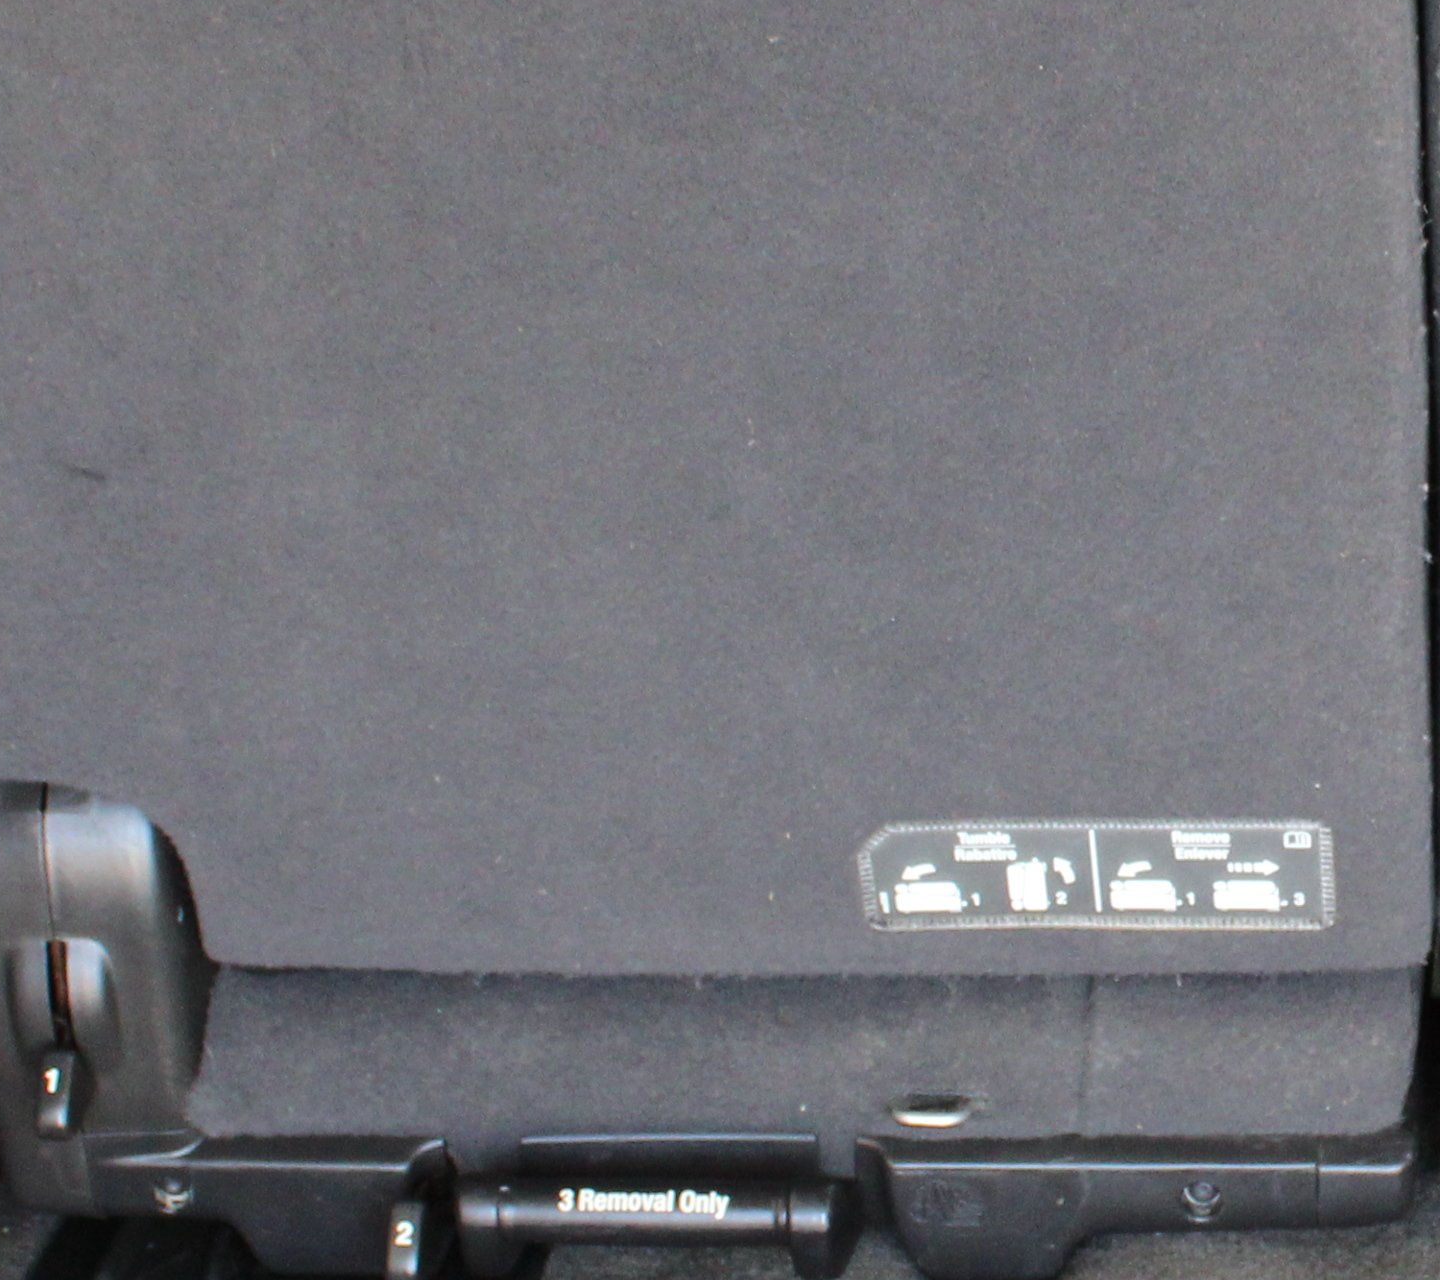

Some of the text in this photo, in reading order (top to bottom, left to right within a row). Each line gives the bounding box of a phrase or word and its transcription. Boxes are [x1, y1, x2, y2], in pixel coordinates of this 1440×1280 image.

[957, 831, 1011, 845] Tumble
[1171, 830, 1231, 844] Remove
[970, 892, 981, 906] 1
[1055, 891, 1068, 905] 2
[1186, 892, 1196, 906] 1
[1293, 892, 1306, 906] 3
[43, 1067, 62, 1094] 1
[558, 1189, 730, 1219] 3 Removal Only
[395, 1222, 413, 1245] 2
